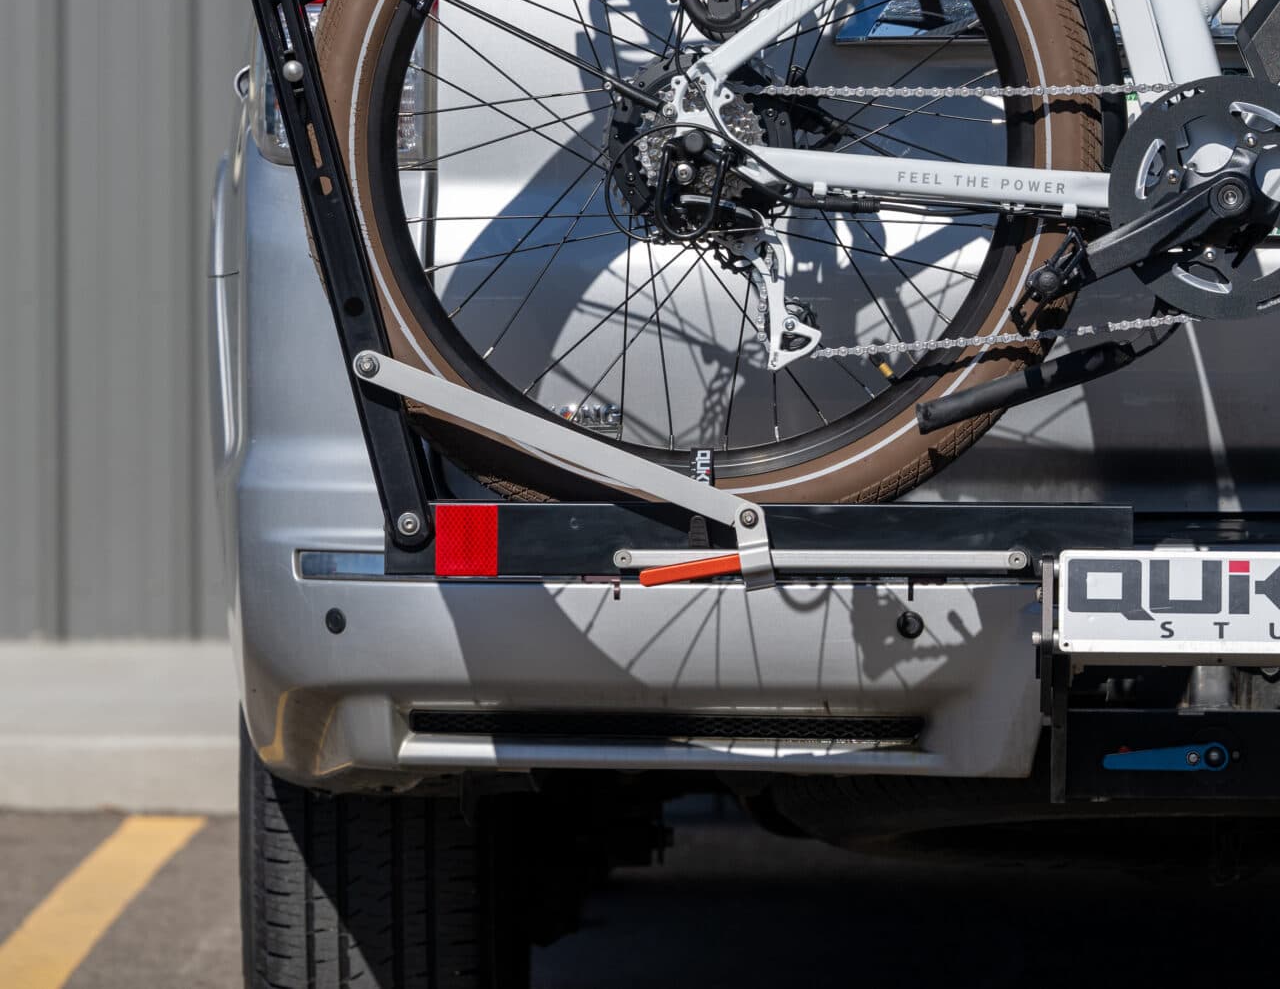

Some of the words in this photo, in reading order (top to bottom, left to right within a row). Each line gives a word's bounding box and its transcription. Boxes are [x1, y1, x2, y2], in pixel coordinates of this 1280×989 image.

[898, 171, 942, 185] FEEL
[954, 174, 989, 188] THE
[1001, 178, 1065, 194] POWER
[696, 450, 711, 484] QUiK
